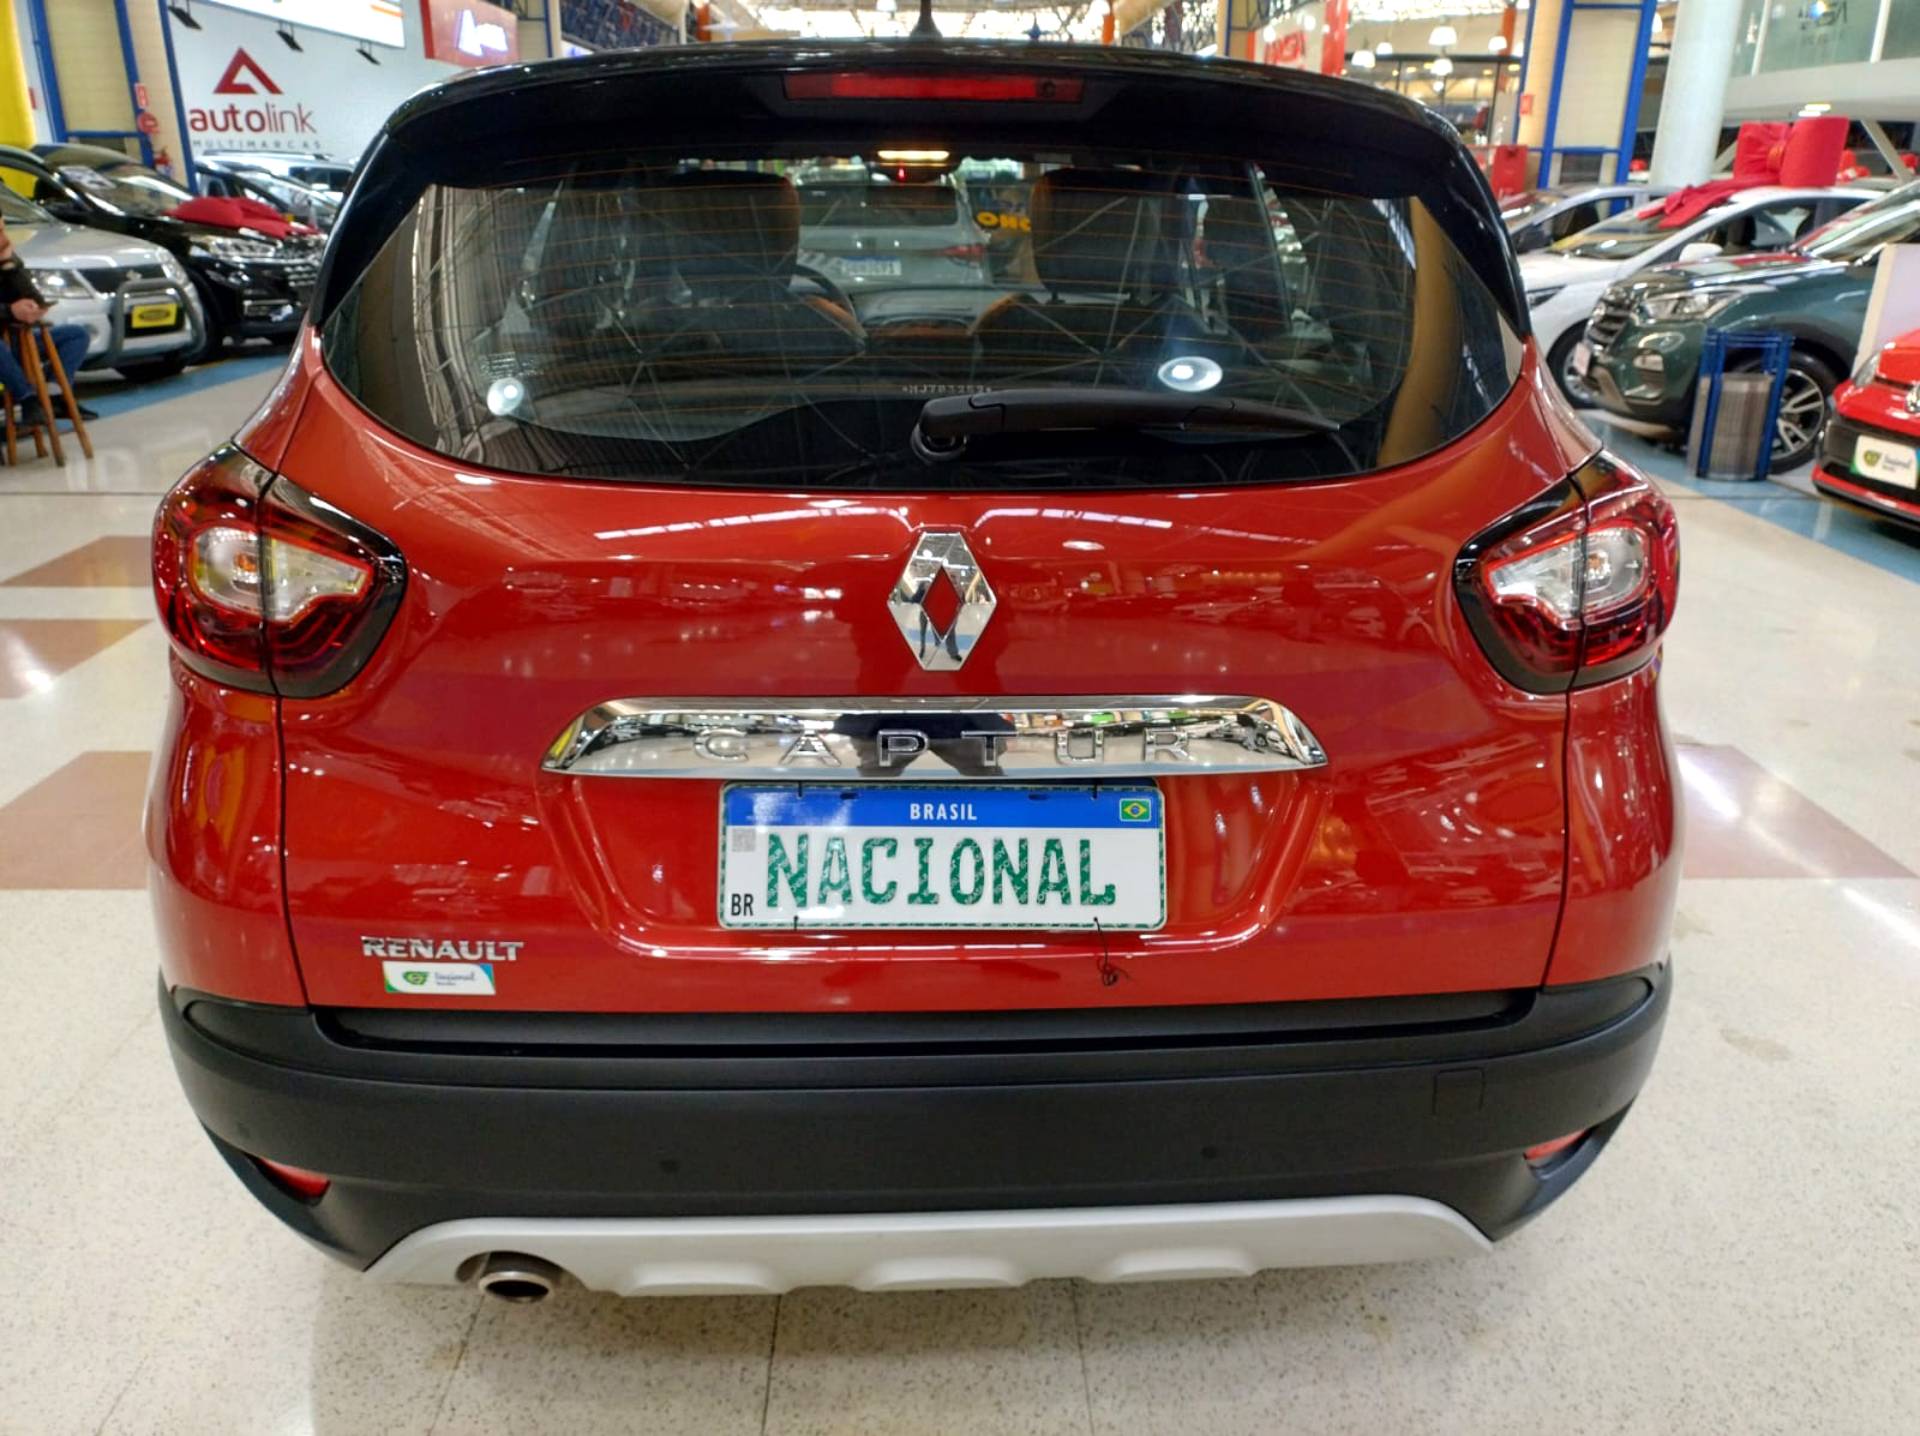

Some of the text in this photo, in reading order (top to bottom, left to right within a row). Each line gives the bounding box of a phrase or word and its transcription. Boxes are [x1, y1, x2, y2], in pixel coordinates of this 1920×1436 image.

[189, 102, 317, 133] autolink
[693, 727, 1191, 767] CAPTUR
[909, 803, 978, 821] BRASIL
[766, 833, 1116, 908] NACIONAL
[730, 893, 754, 917] BR
[360, 935, 525, 962] RENAULT
